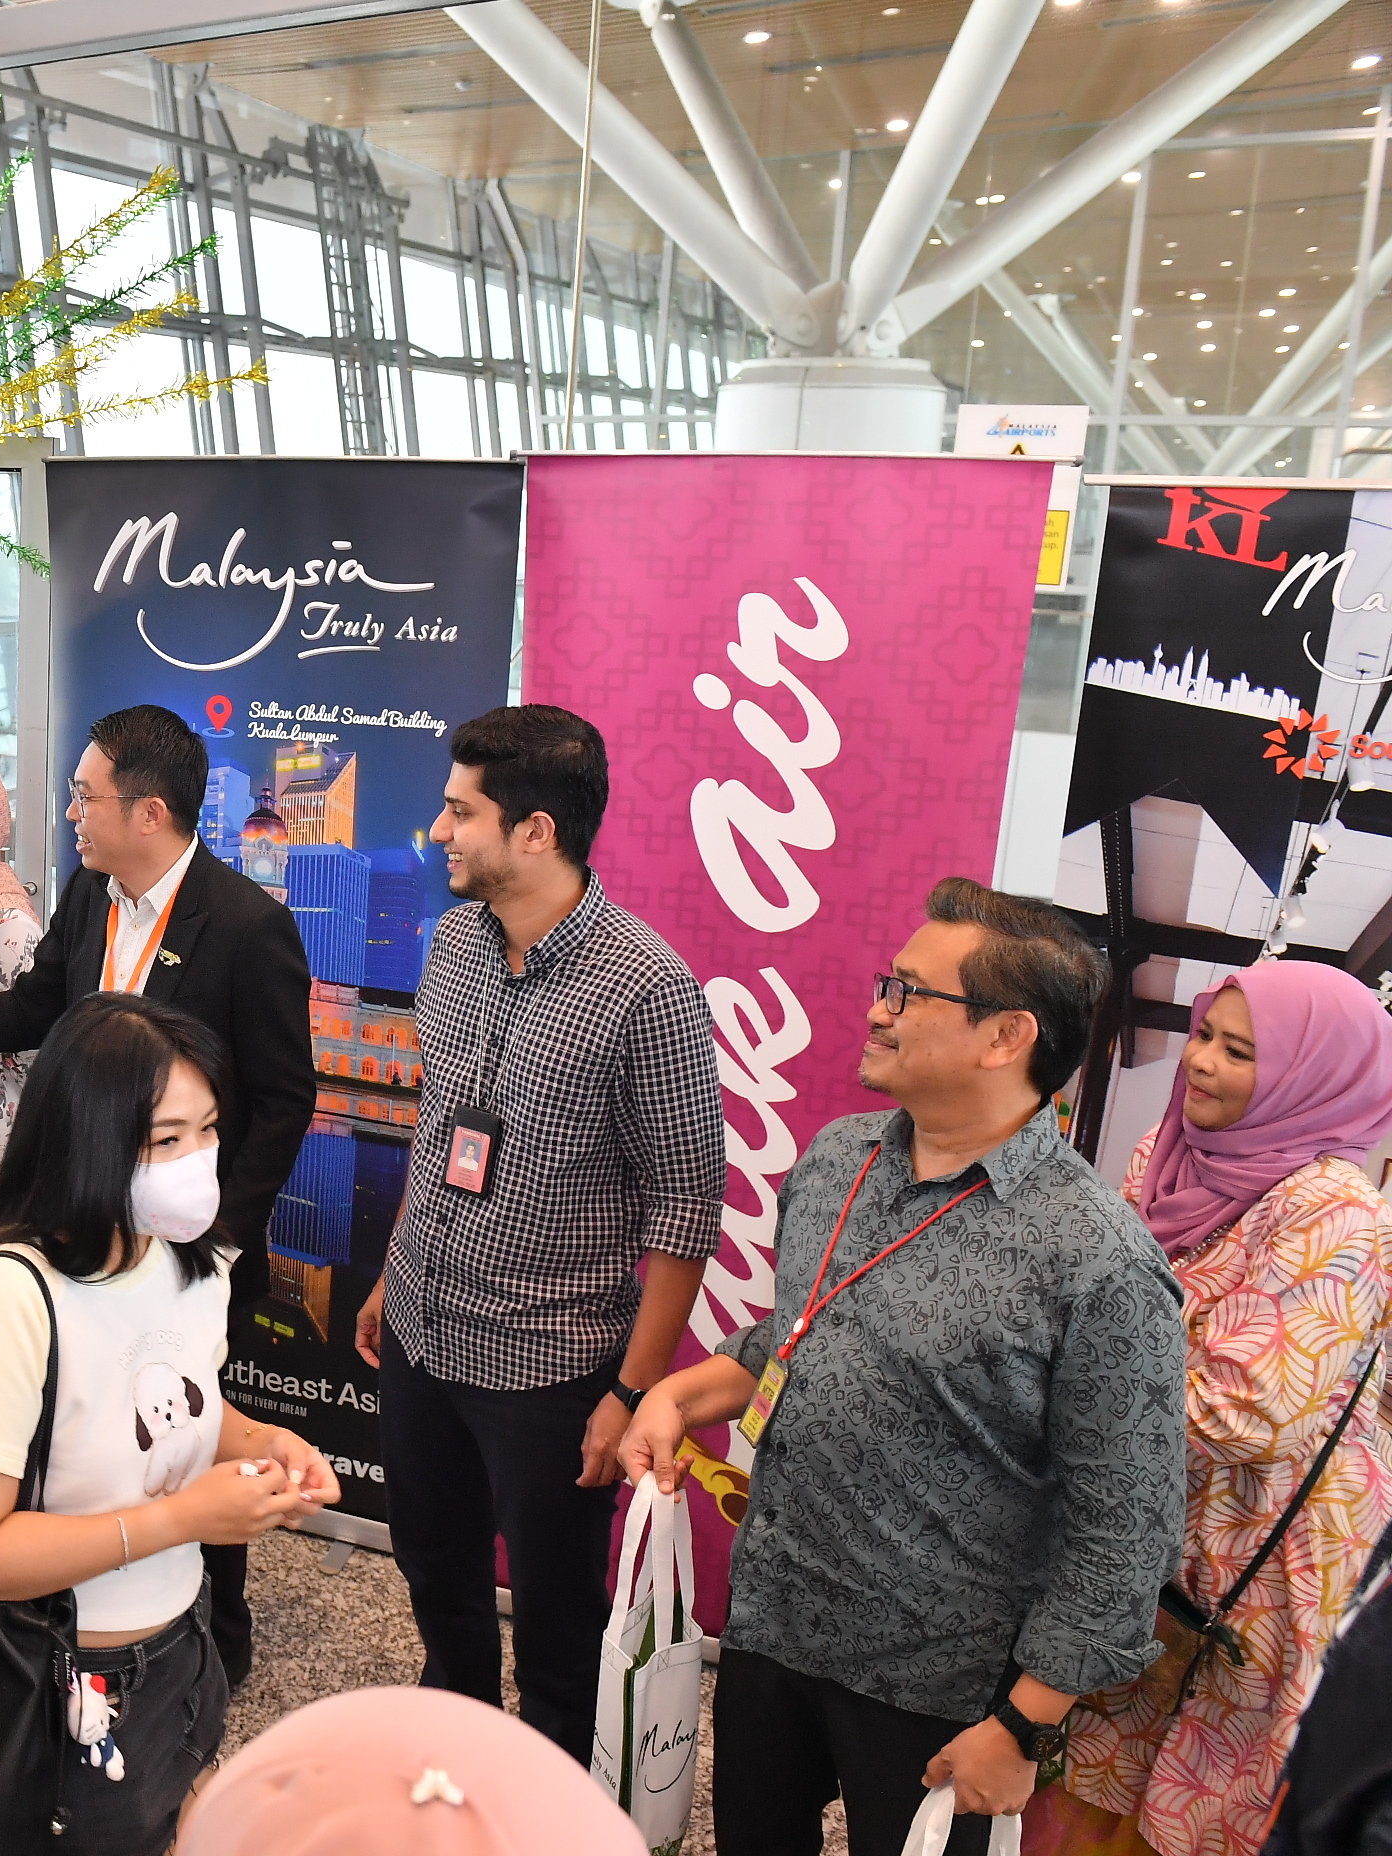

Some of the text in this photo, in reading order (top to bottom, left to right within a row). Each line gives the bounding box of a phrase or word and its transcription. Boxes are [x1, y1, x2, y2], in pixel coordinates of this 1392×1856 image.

[93, 511, 436, 672] Malaysia
[300, 601, 458, 646] Truly Asia
[247, 722, 339, 748] Kuala Lumpur
[248, 701, 448, 738] Sultan Abdul Samad Building
[223, 1360, 380, 1414] utheast Asi
[238, 1392, 253, 1405] FOR
[254, 1396, 278, 1411] EVERY
[279, 1402, 308, 1417] DREAM
